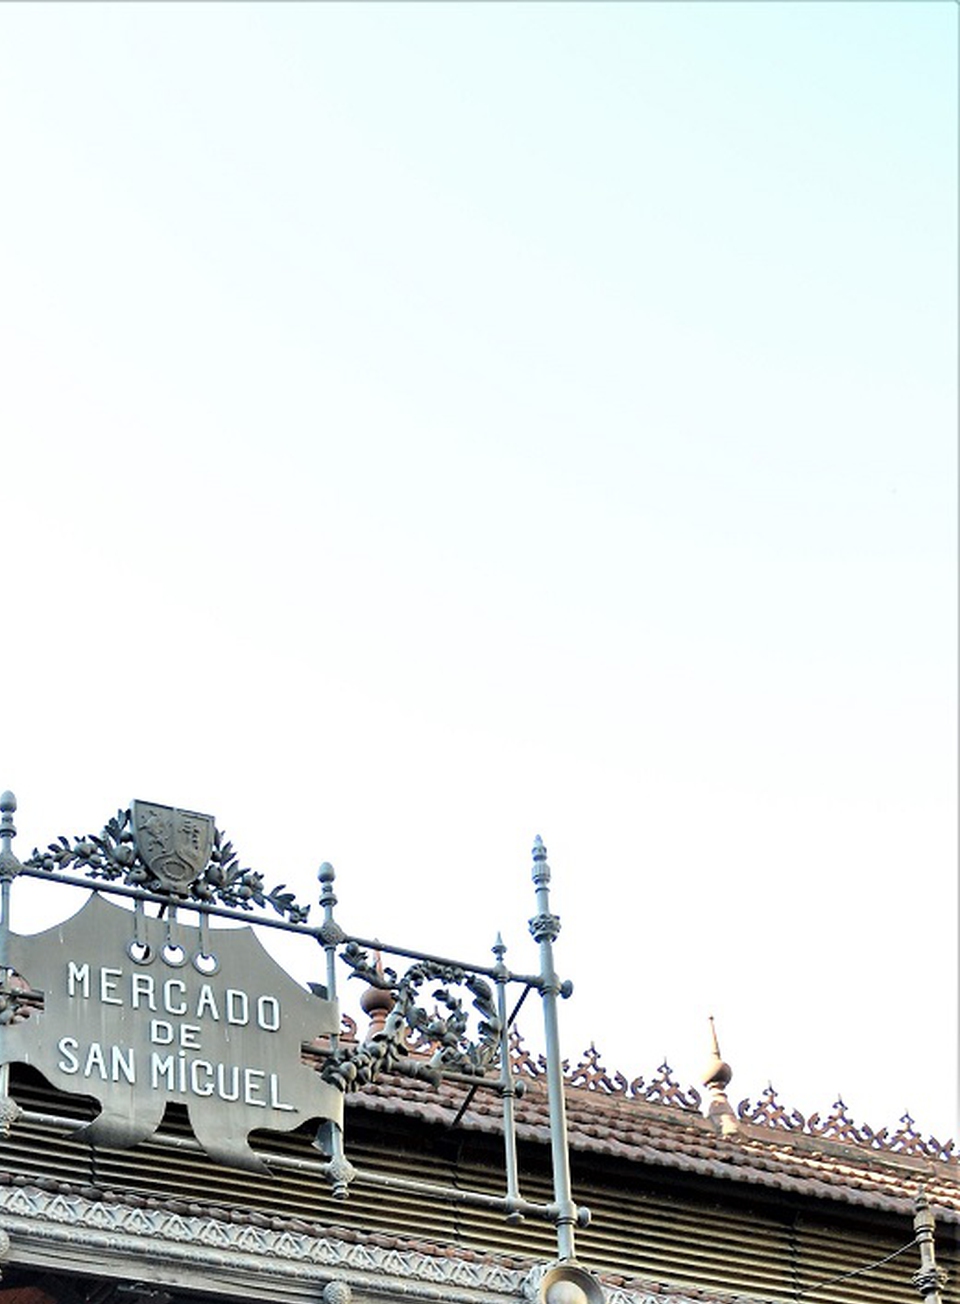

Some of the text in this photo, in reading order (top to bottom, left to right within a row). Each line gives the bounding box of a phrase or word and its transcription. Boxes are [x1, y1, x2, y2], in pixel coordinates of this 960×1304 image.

[67, 961, 282, 1032] MERCADO
[150, 1019, 201, 1050] DE
[58, 1037, 136, 1084] SAN
